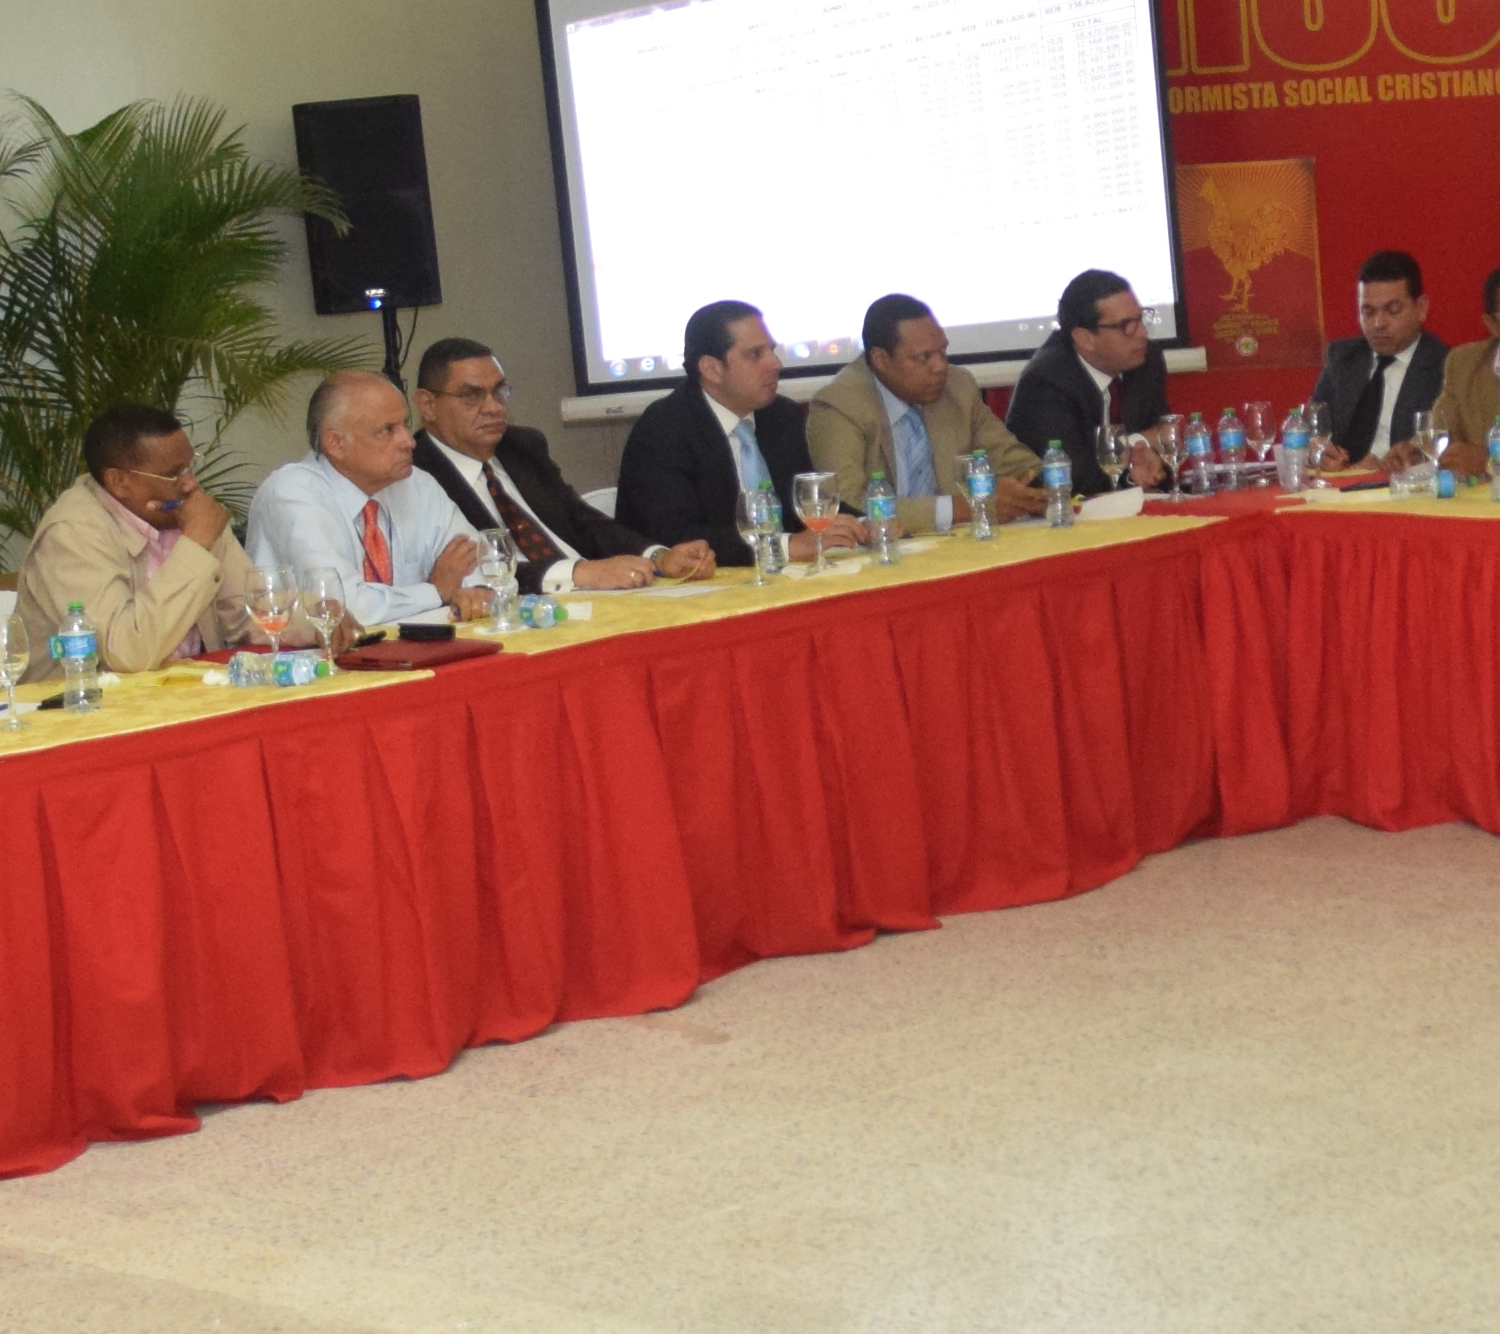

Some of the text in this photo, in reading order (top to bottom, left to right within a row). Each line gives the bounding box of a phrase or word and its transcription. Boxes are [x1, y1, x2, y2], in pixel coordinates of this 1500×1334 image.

[1072, 17, 1104, 29] TOTAL
[980, 34, 1021, 48] AGOSTO
[1169, 81, 1278, 114] ORMISTA
[1284, 74, 1372, 107] SOCIAL
